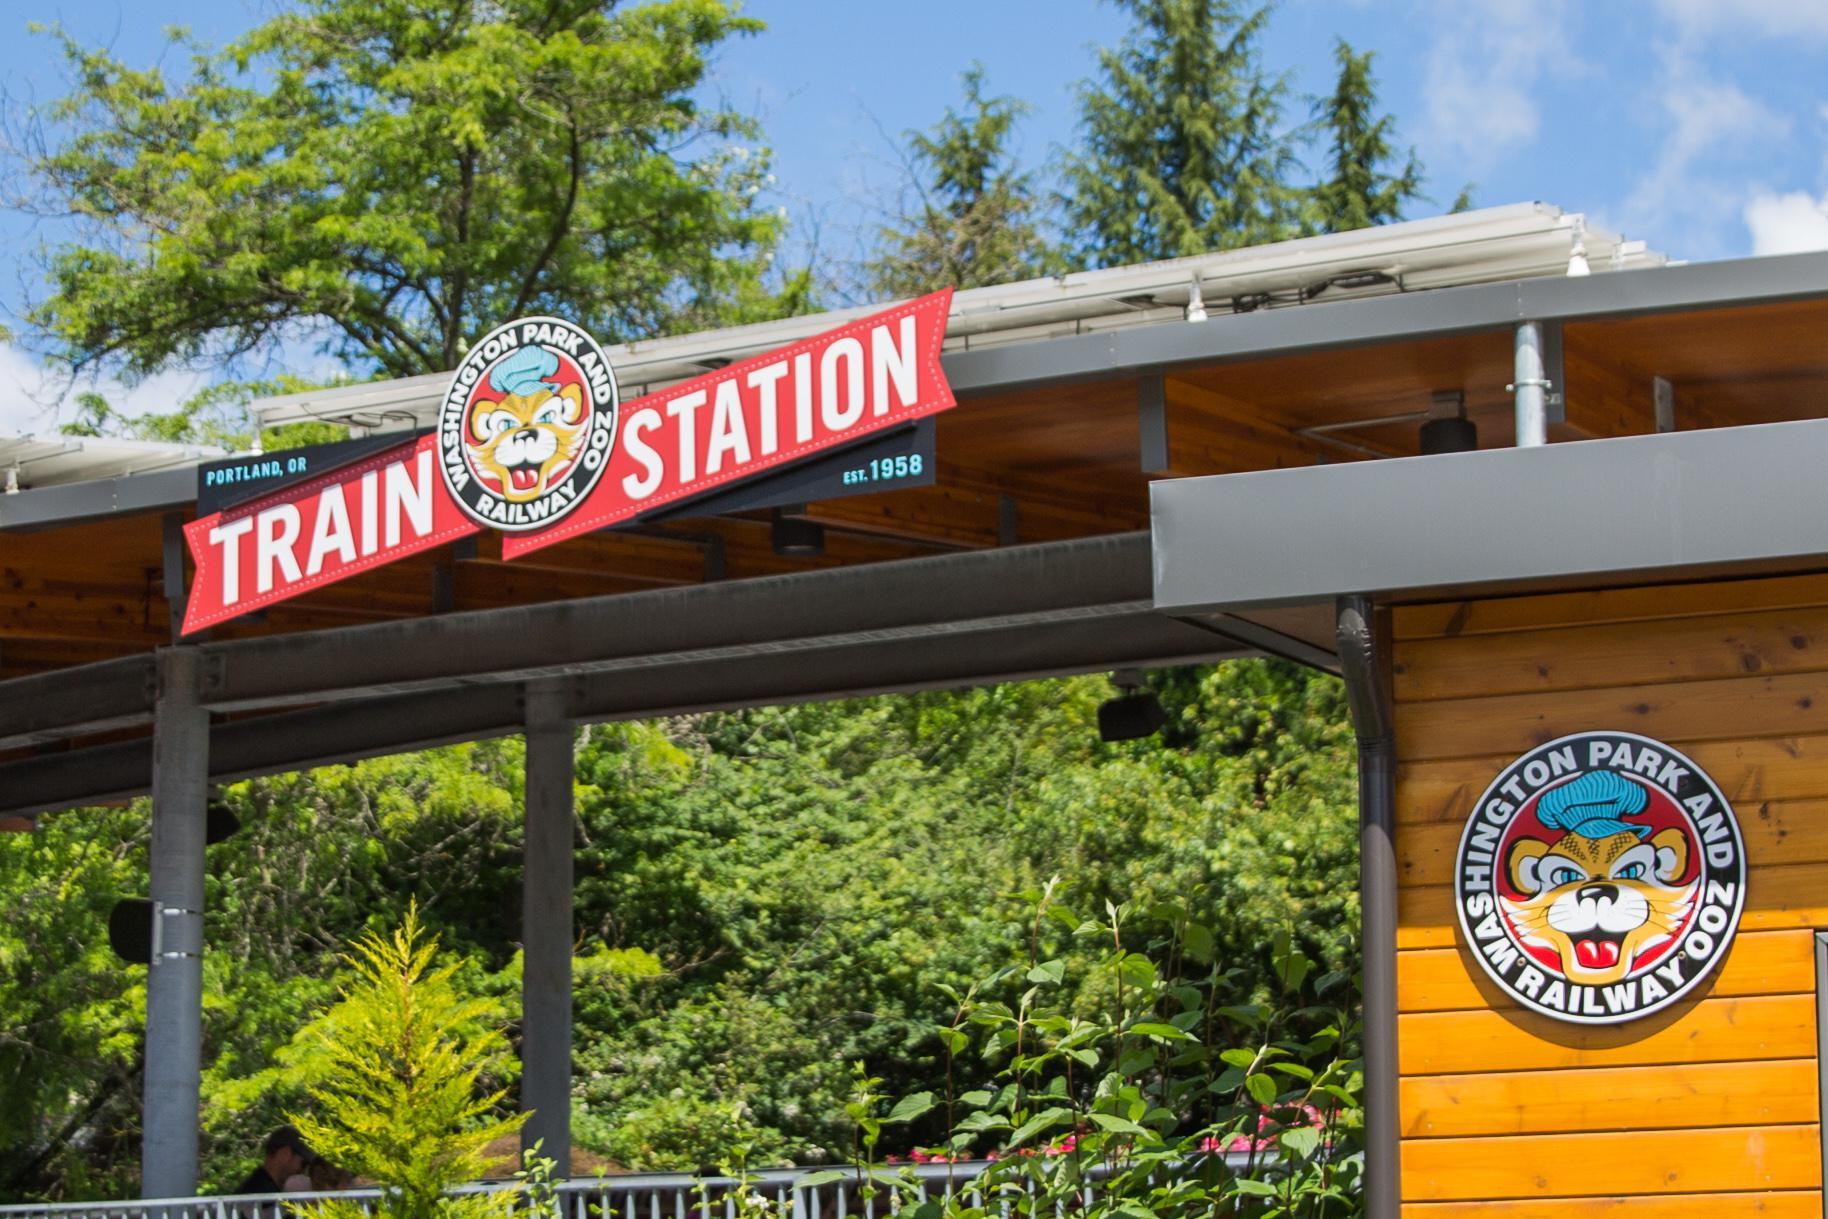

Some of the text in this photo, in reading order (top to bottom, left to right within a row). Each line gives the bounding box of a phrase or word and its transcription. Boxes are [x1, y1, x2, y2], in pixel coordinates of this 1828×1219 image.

[443, 324, 612, 492] WASHINGTON PARK AND ZOO
[206, 456, 307, 487] PORTLAND, OR
[209, 314, 918, 606] TRAIN STATION
[843, 454, 923, 485] EST. 1958
[475, 478, 577, 523] RAILWAY
[1465, 740, 1735, 976] WASHINGTON PARK AND ZOO
[1515, 961, 1686, 1015] RAILWAY
